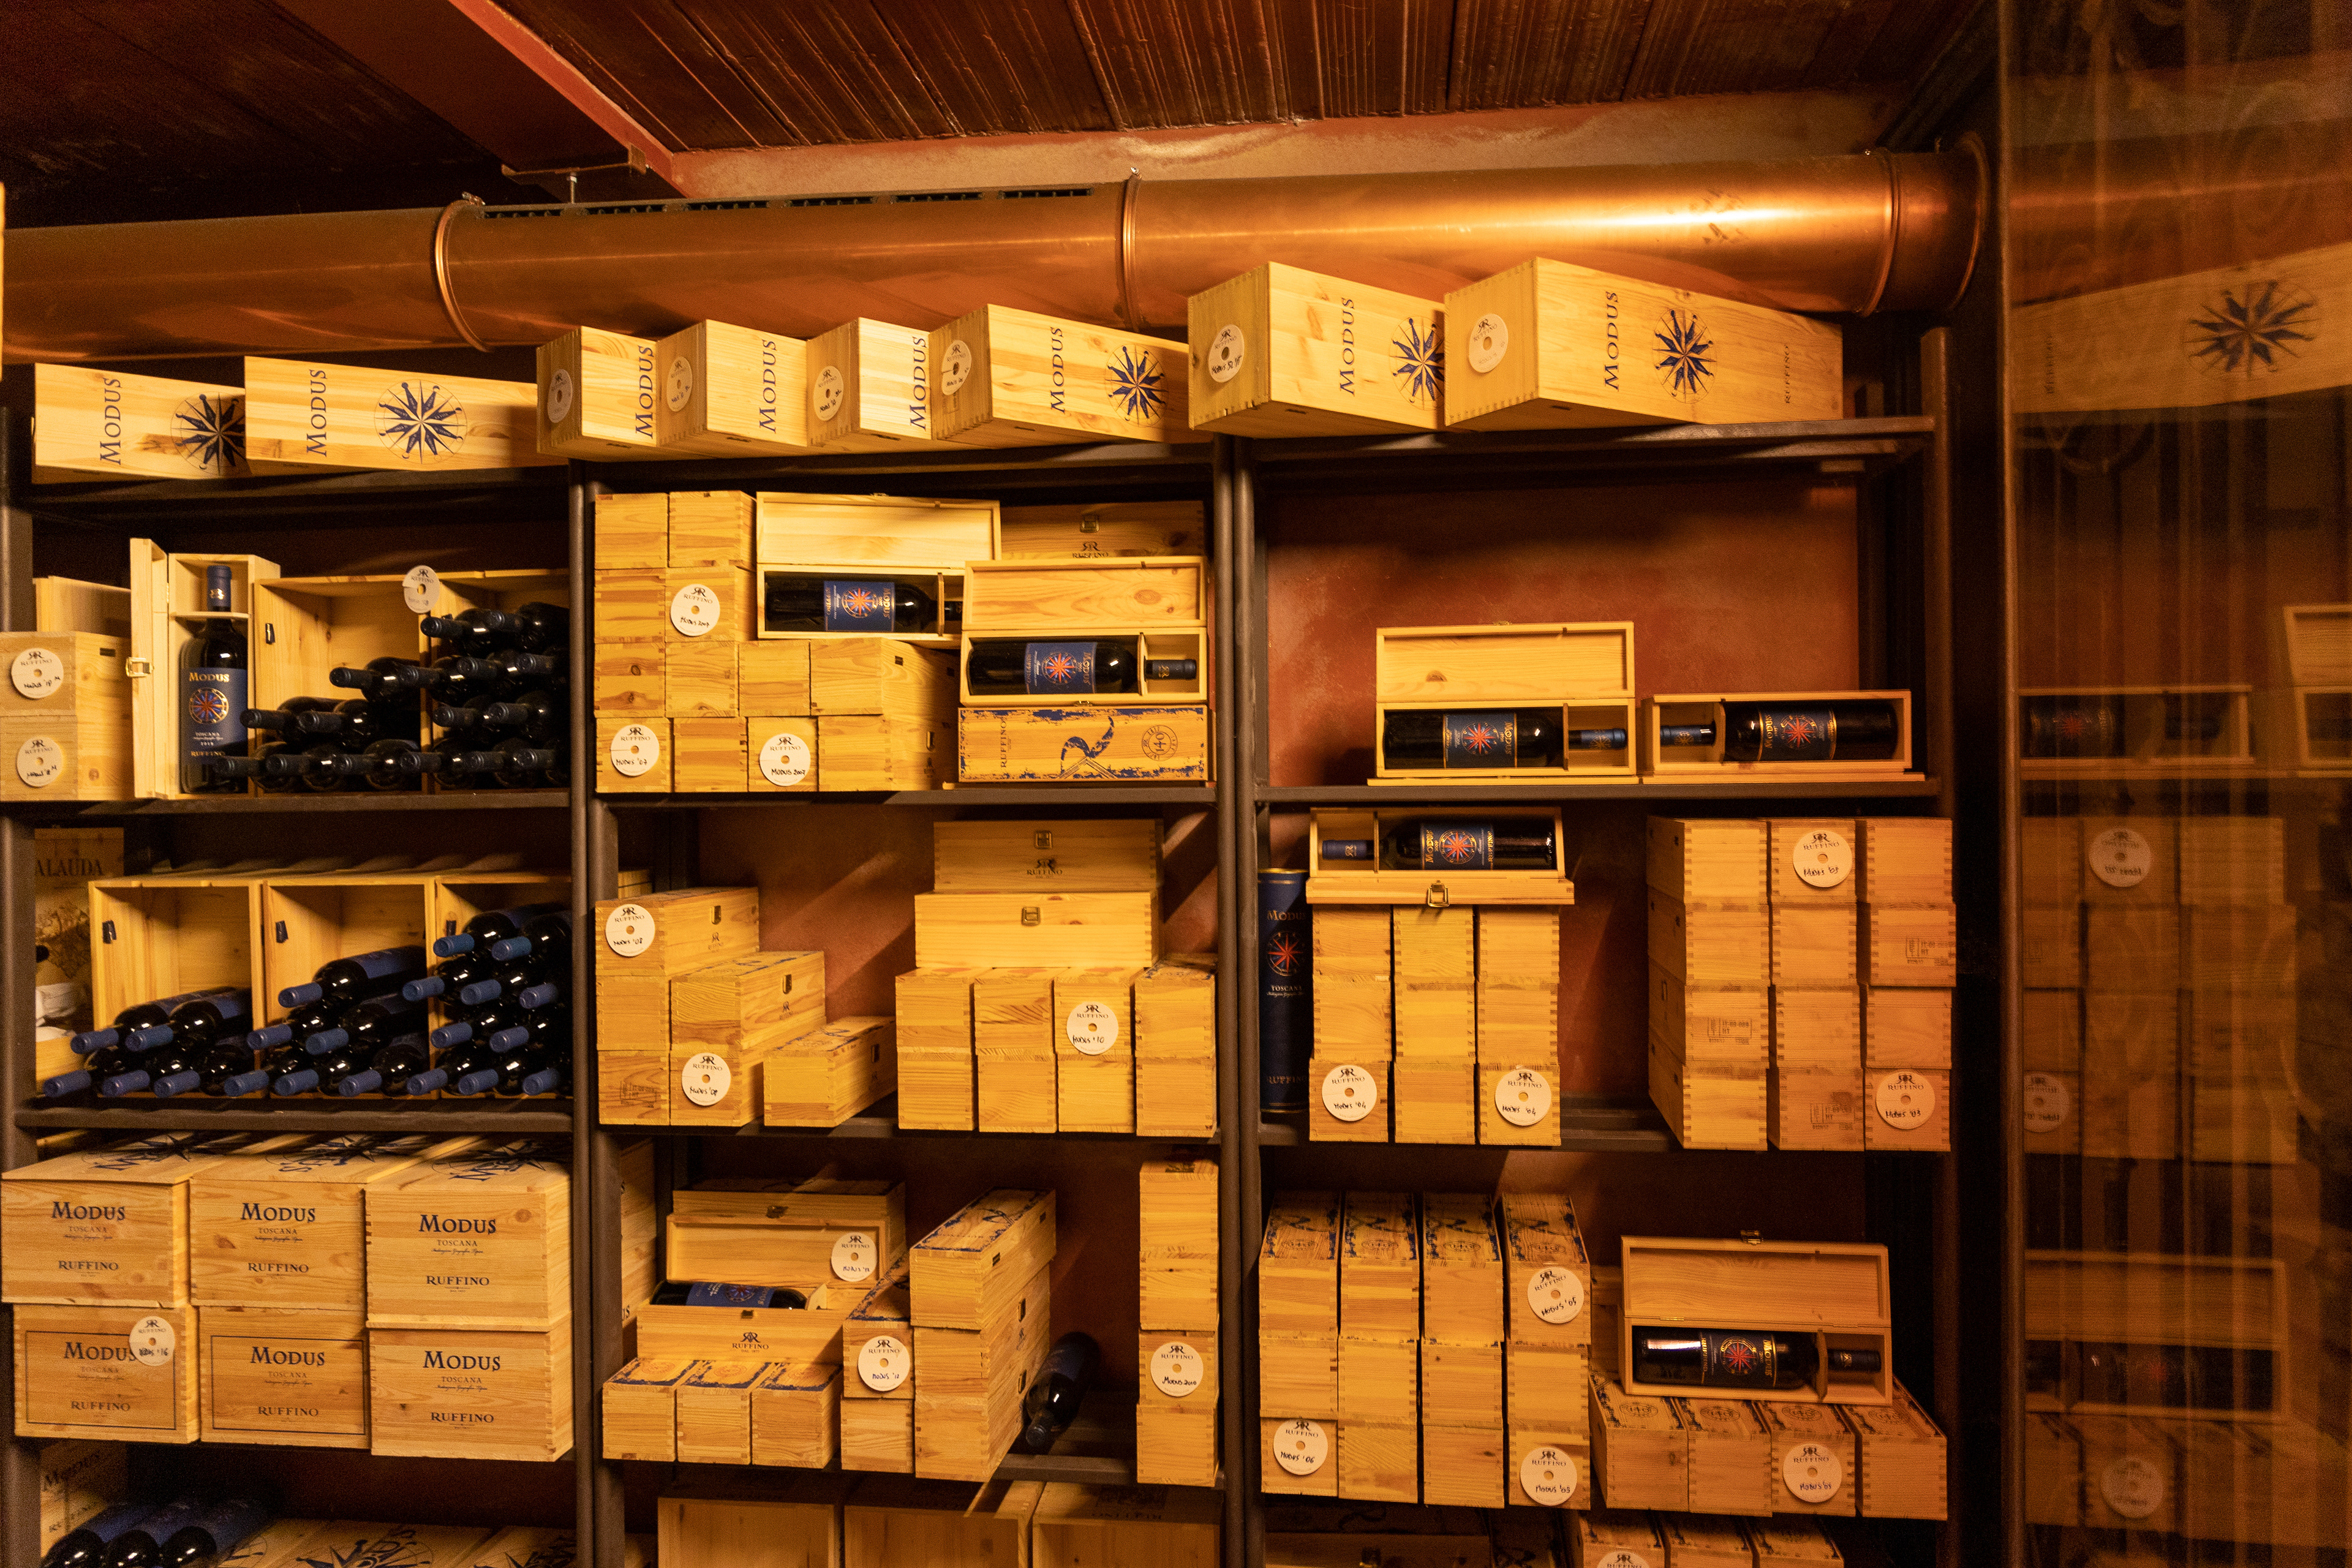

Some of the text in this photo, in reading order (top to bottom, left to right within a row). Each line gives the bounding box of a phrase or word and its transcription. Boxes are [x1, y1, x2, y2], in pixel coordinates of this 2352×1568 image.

[1340, 297, 1355, 397] MODUS
[1604, 291, 1619, 391] MODUS
[1050, 327, 1066, 414] MODUS
[635, 345, 654, 439] MODUS
[759, 339, 777, 434] MODUS
[910, 336, 929, 431] MODUS
[100, 377, 123, 466] MODUS
[306, 369, 327, 457] MODUS
[684, 595, 712, 604] RUFFINO
[189, 672, 230, 683] MODUS
[1082, 652, 1091, 685] MODUS
[1504, 722, 1513, 756] MODUS
[1765, 714, 1773, 748] MODUS
[1153, 733, 1166, 751] 140
[51, 1201, 126, 1221] MODUS
[241, 1202, 315, 1223] MODUS
[419, 1214, 496, 1235] MODUS
[59, 1261, 119, 1272] RUFFINO
[248, 1262, 309, 1273] RUFFINO
[426, 1275, 489, 1286] RUFFINO
[1535, 1276, 1566, 1292] RUFFINO
[1541, 1303, 1564, 1316] MODUS
[64, 1341, 138, 1362] MODUS
[250, 1346, 325, 1367] MODUS
[423, 1351, 500, 1371] MODUS
[1763, 1339, 1773, 1378] MODUS
[71, 1401, 130, 1411] RUFFINO
[258, 1406, 318, 1417] RUFFINO
[431, 1412, 494, 1423] RUFFINO
[1281, 1452, 1300, 1461] MODUS
